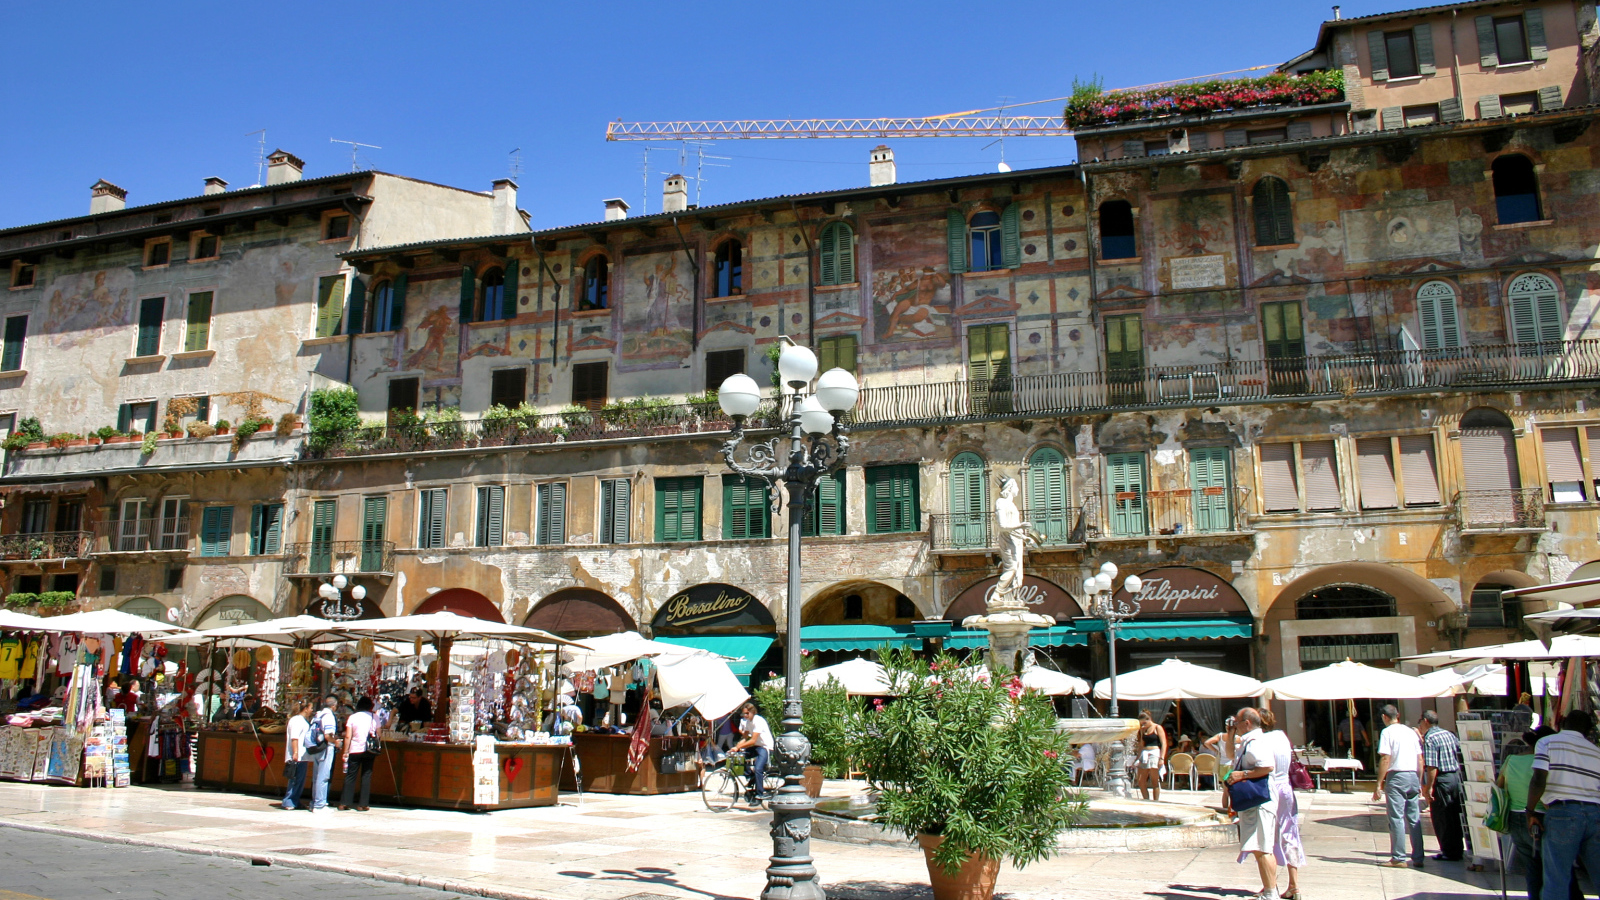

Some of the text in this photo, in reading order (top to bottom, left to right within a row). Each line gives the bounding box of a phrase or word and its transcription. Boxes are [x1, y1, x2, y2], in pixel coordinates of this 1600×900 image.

[667, 590, 752, 625] Borsalino
[984, 584, 1048, 605] Cffè
[1134, 577, 1219, 611] Filippini
[6, 648, 12, 661] 7
